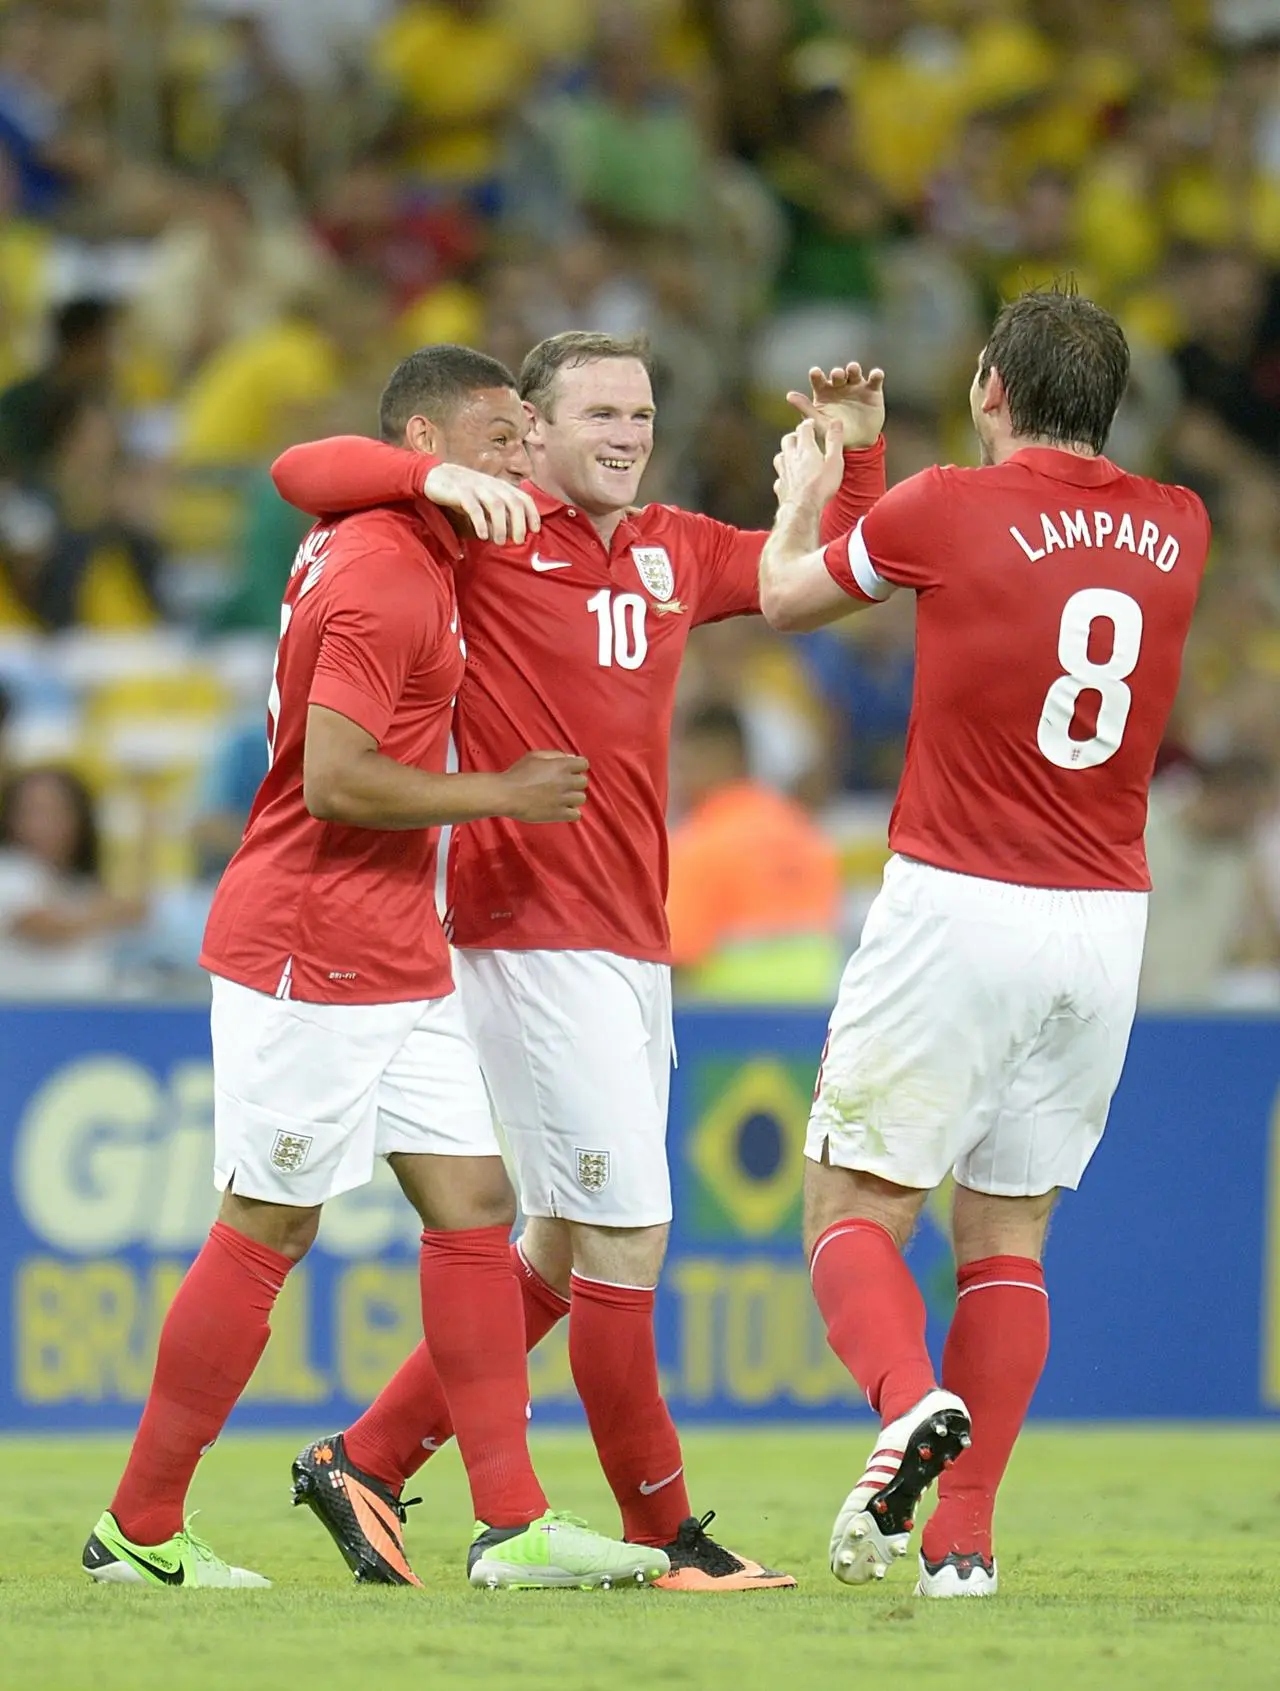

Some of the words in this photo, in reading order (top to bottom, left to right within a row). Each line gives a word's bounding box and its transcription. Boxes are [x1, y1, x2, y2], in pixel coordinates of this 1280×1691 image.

[1009, 509, 1180, 573] LAMPARD
[587, 588, 648, 670] 10
[1037, 588, 1143, 770] 8
